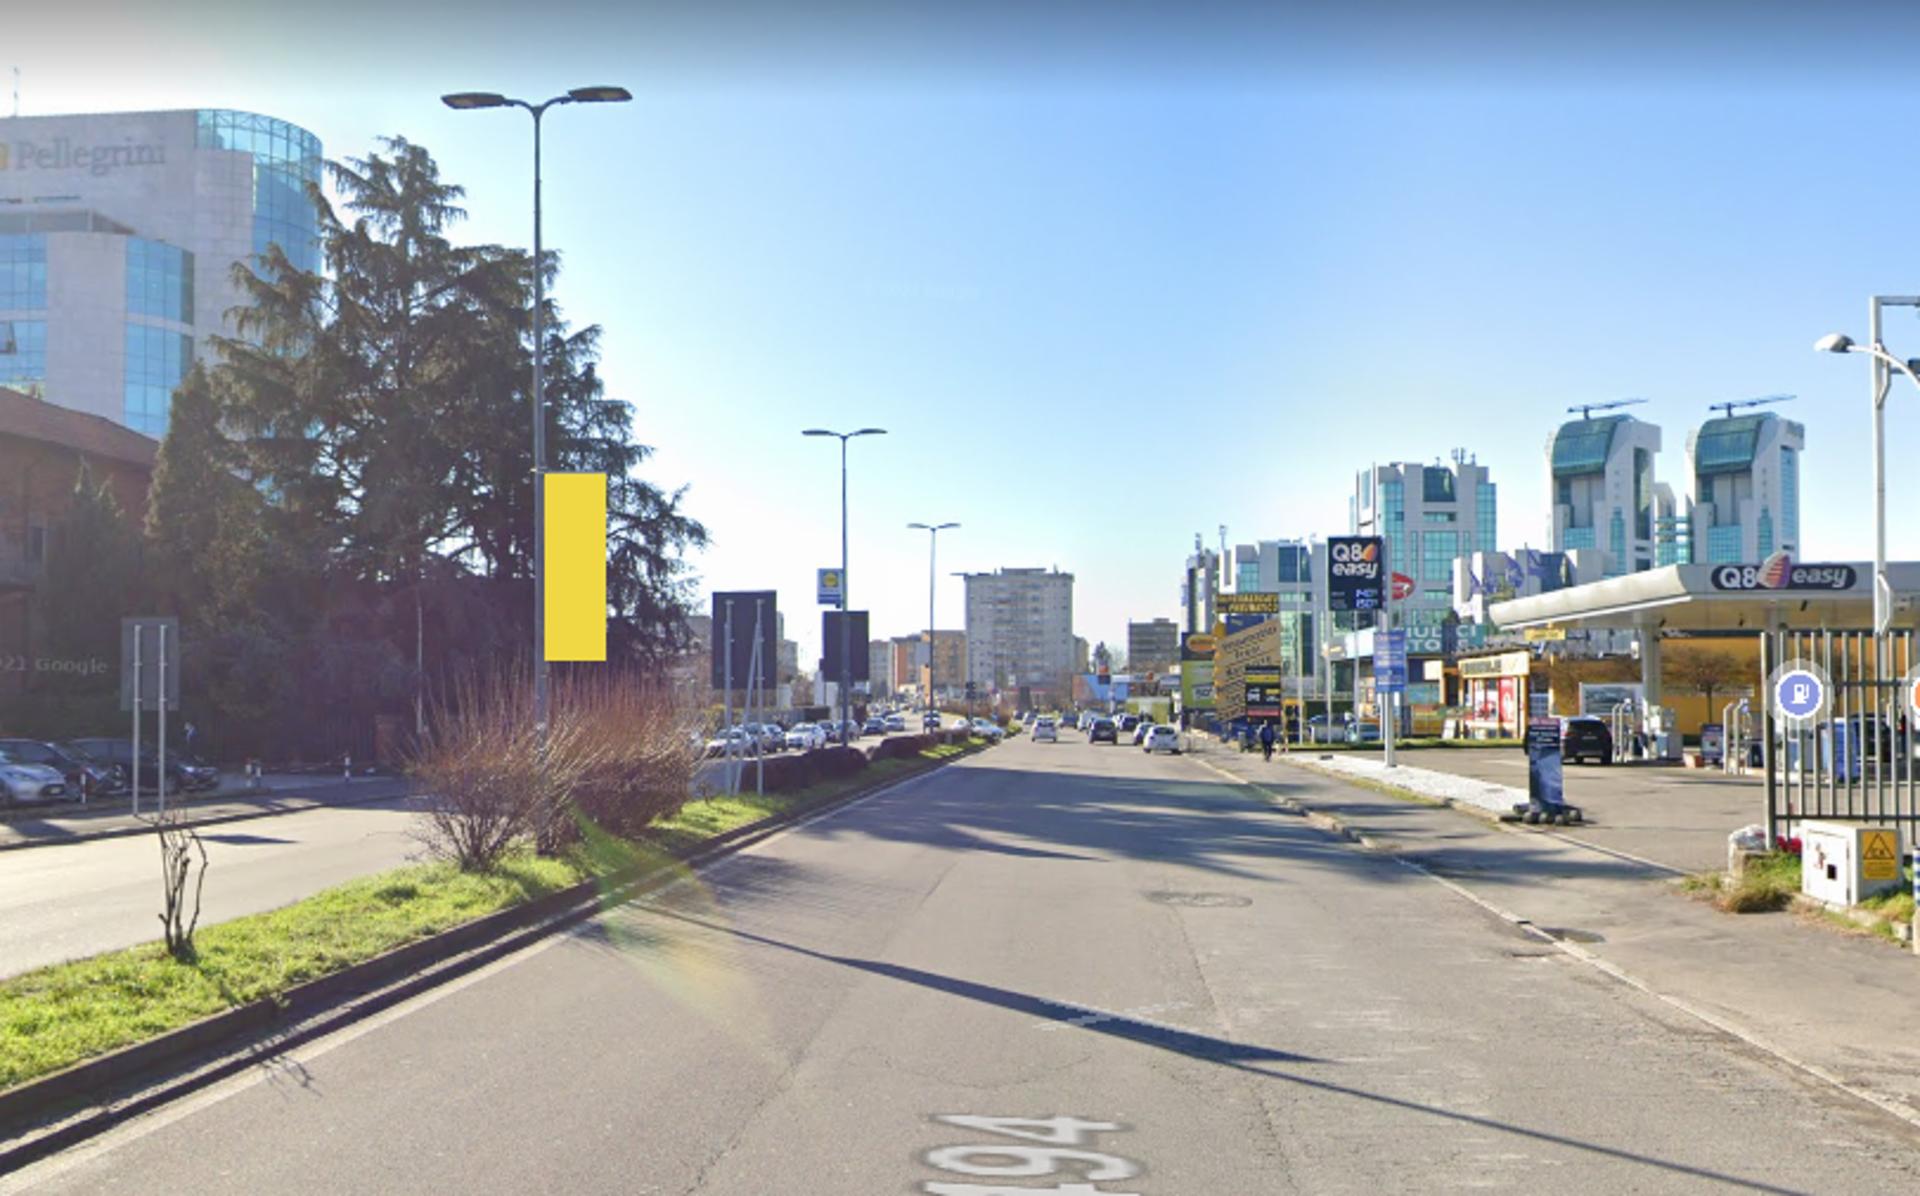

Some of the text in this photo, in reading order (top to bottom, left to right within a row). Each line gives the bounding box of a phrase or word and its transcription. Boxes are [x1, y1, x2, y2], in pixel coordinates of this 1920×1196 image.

[15, 137, 166, 176] Pellegrini
[1332, 542, 1362, 562] Q8
[1332, 562, 1378, 579] easy
[1719, 567, 1848, 588] Q8 easy
